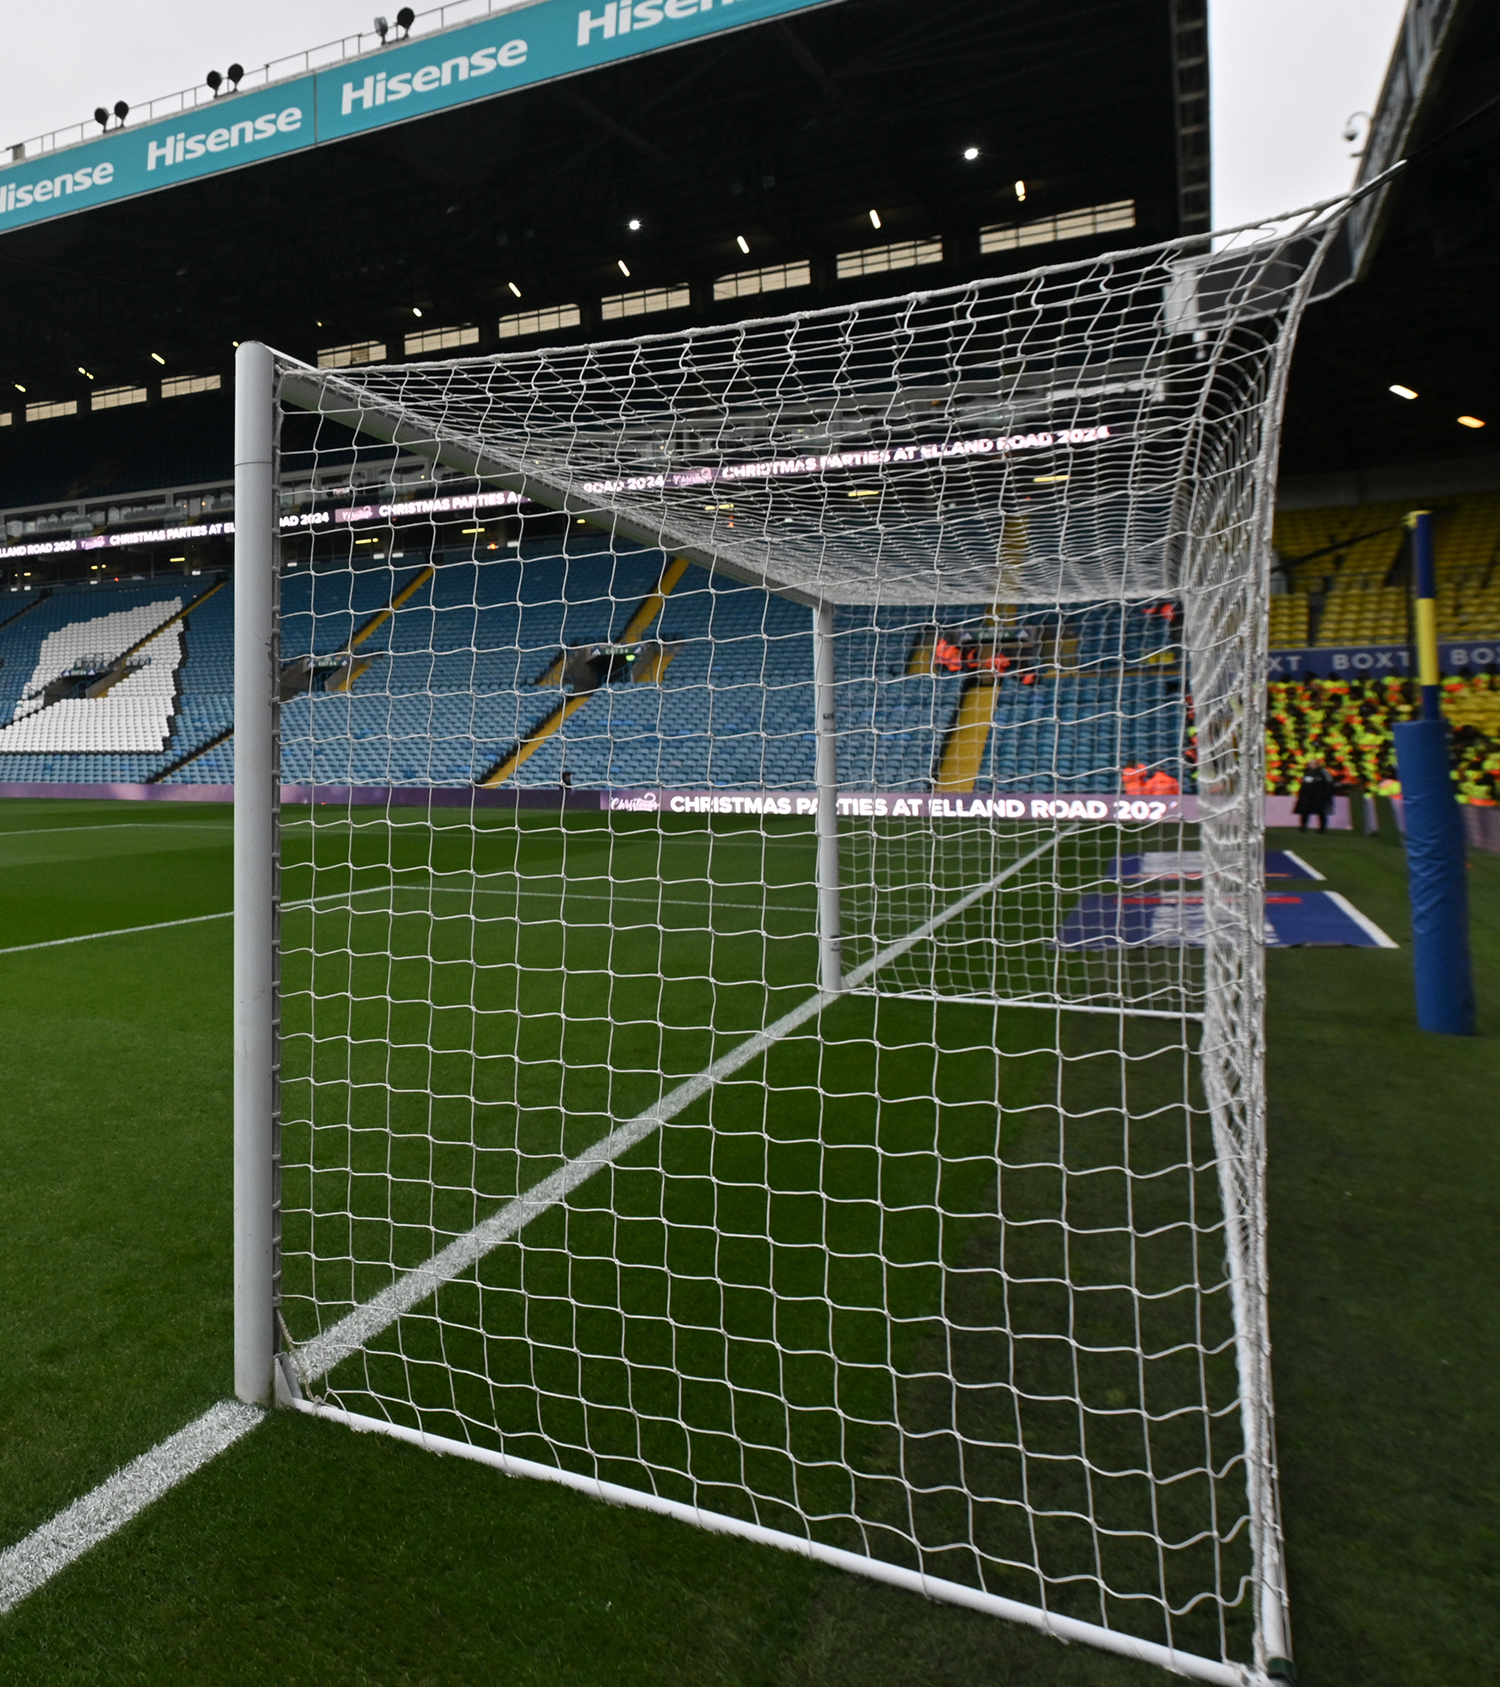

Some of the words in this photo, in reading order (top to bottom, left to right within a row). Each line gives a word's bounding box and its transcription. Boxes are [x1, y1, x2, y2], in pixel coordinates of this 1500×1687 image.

[577, 0, 750, 47] Hise
[341, 39, 528, 116] Hisense
[147, 106, 302, 171] Hisense
[722, 457, 817, 478] CHRISTMAS
[894, 446, 917, 461] AT
[921, 439, 994, 458] ELLAND
[627, 475, 664, 490] 2024
[379, 498, 451, 517] CHRISTMAS
[452, 491, 505, 508] PARTIES
[300, 511, 330, 525] 2024
[109, 529, 166, 546] CHRISTMAS
[167, 525, 207, 540] PARTIES
[209, 523, 222, 535] AT
[1332, 651, 1410, 670] BOXT
[1450, 647, 1500, 665] BO
[670, 796, 791, 814] CHRISTMAS
[796, 797, 888, 816] PATIES
[892, 799, 923, 816] AT
[929, 798, 1025, 818] ELLAND
[1031, 799, 1108, 819] ROAD
[1114, 801, 1178, 820] 202
